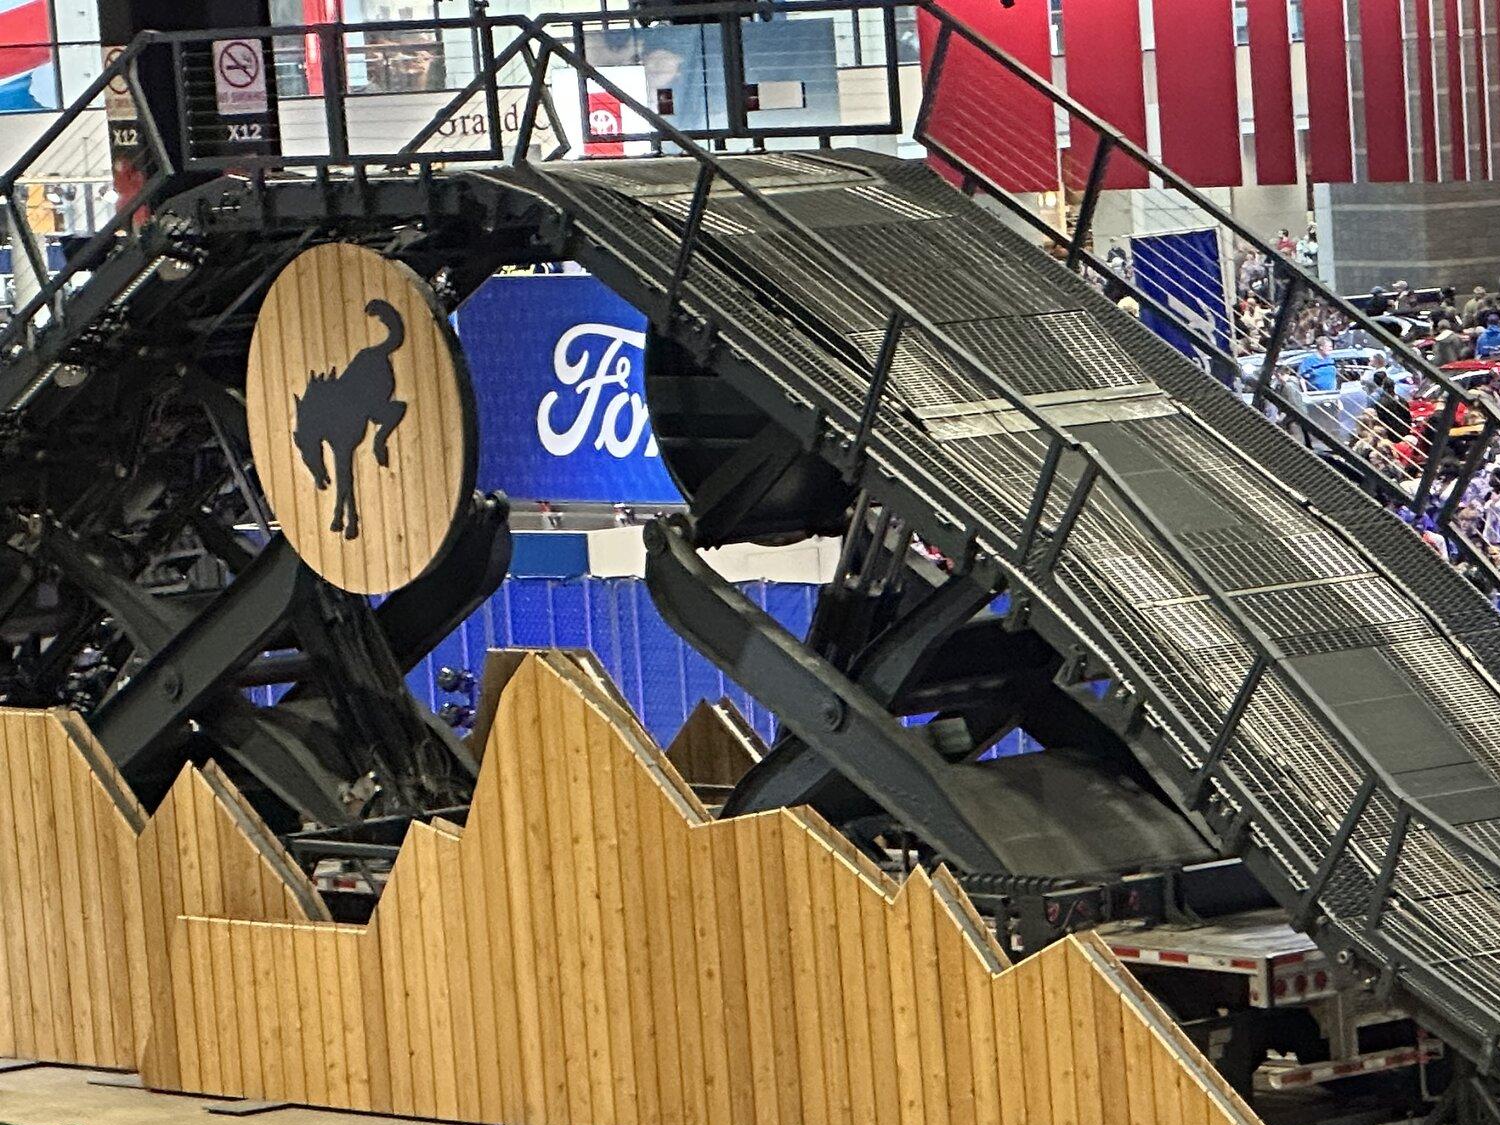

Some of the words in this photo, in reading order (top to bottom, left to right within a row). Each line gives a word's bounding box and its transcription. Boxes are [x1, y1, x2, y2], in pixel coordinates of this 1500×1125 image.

[436, 102, 519, 136] Grad
[113, 128, 138, 146] X12
[226, 124, 262, 141] X12
